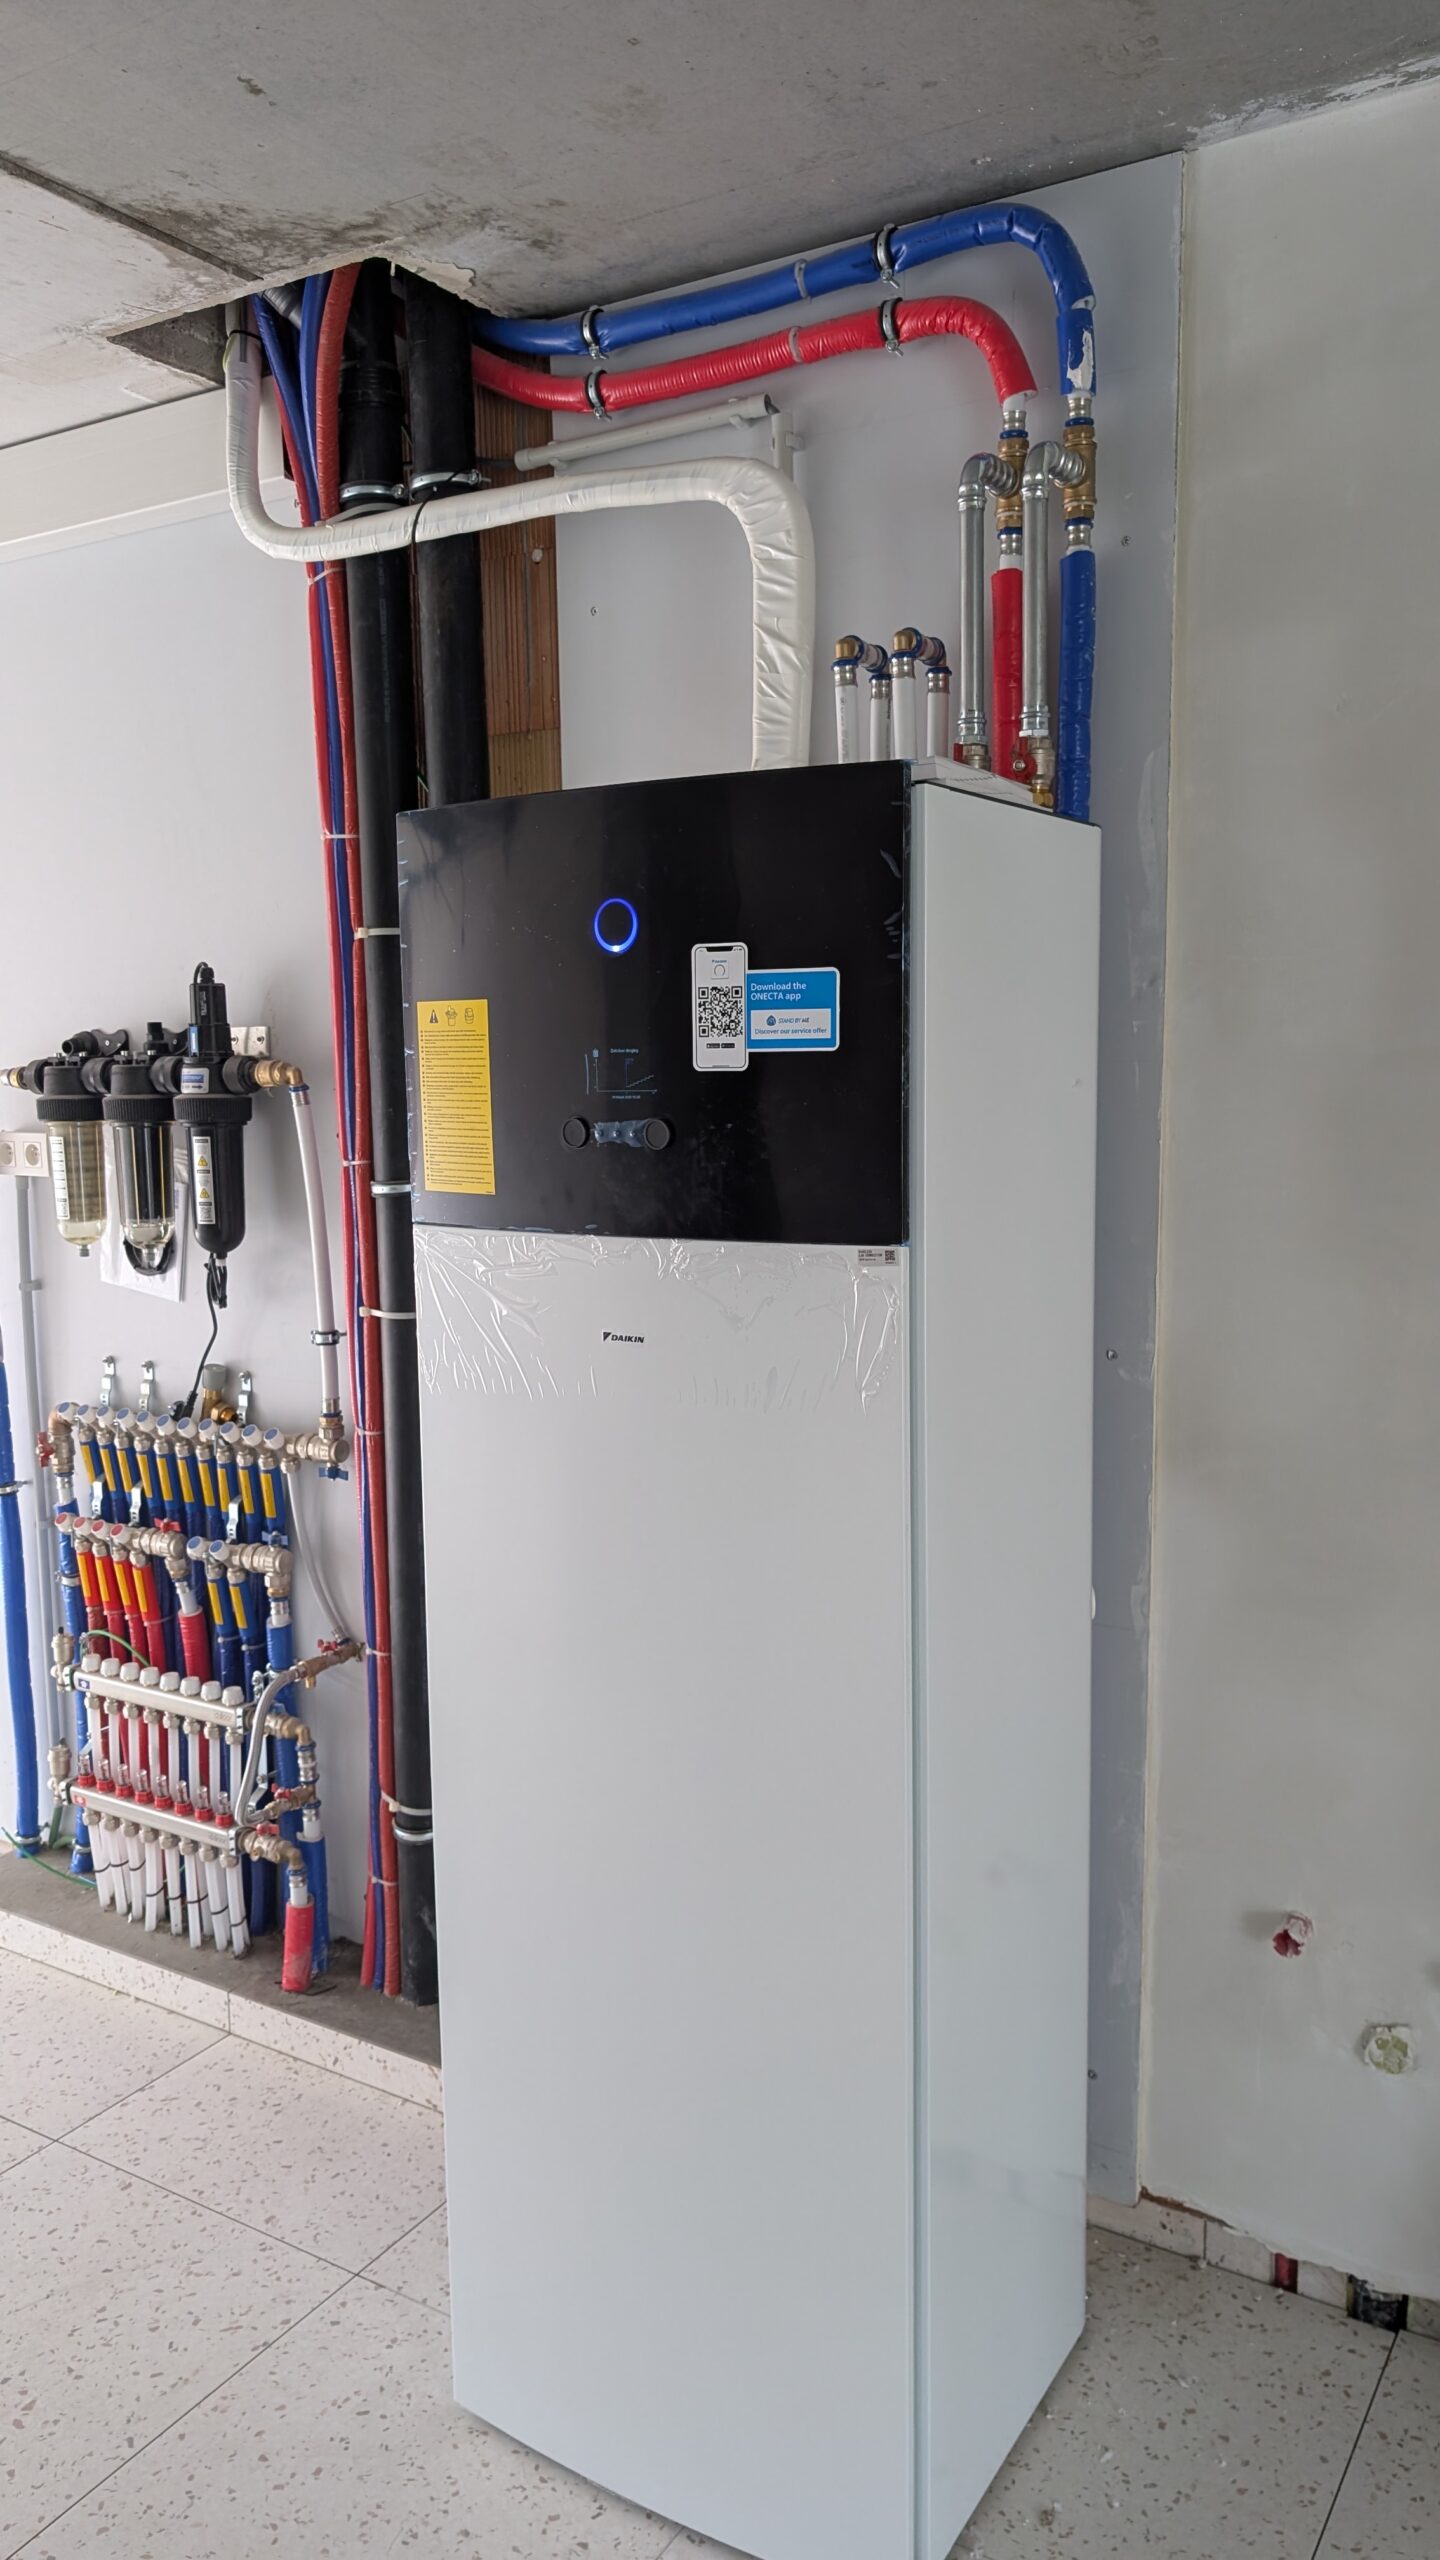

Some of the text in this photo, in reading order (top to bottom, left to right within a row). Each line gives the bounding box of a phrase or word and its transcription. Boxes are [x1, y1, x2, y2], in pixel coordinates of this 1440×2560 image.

[751, 982, 807, 991] Download the
[751, 992, 801, 1002] ONECTA app
[611, 1334, 645, 1343] DAIKIN
